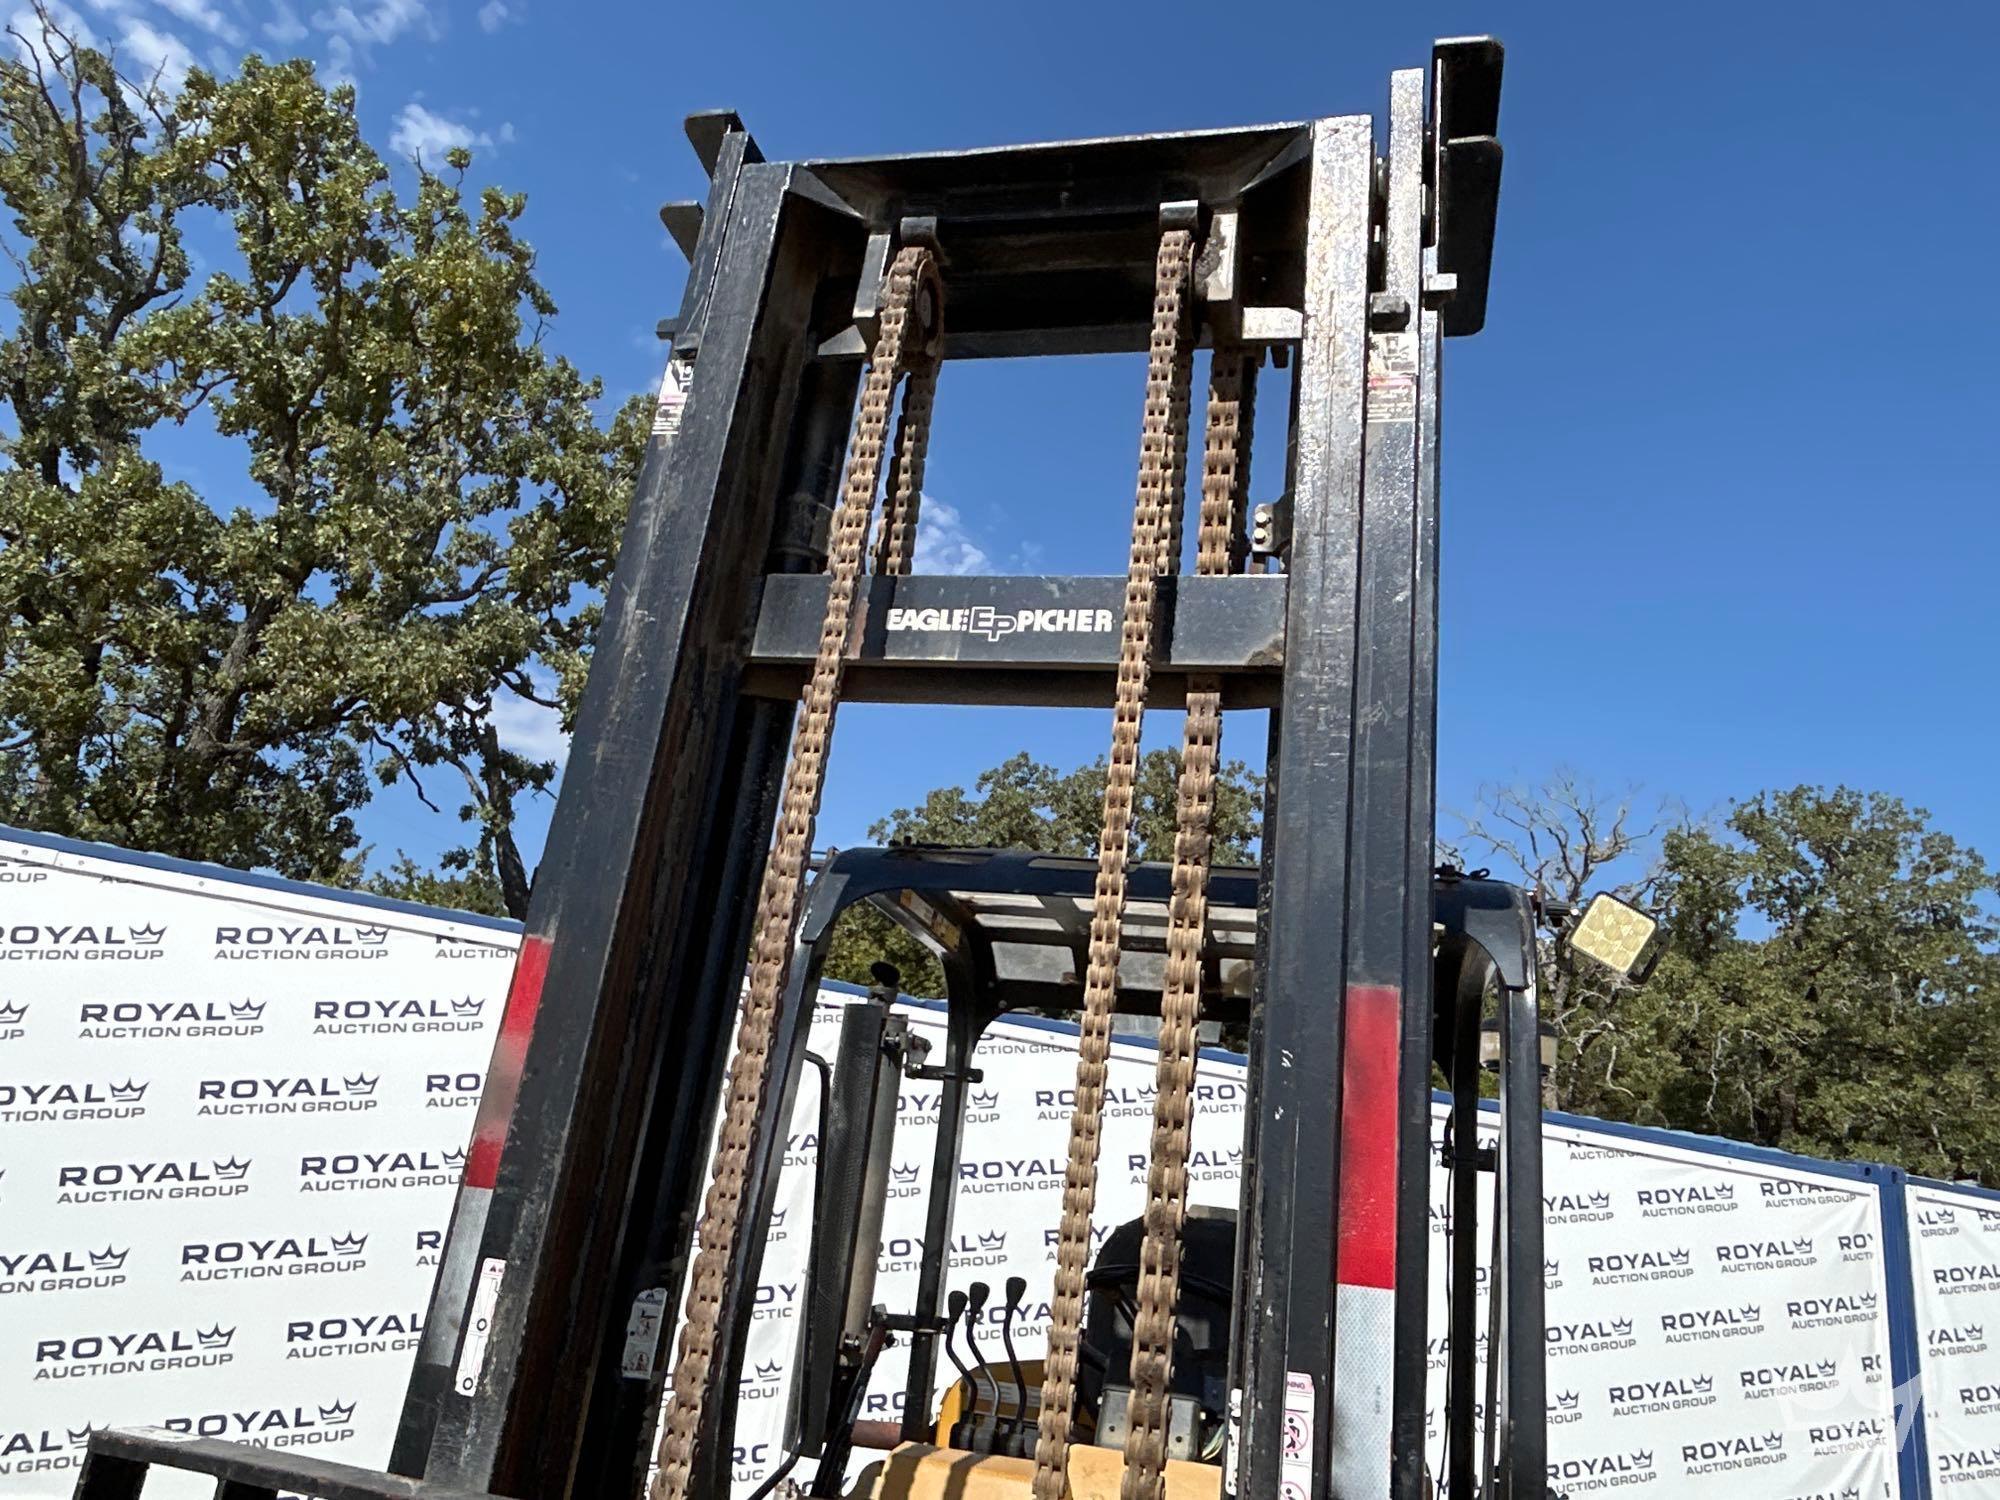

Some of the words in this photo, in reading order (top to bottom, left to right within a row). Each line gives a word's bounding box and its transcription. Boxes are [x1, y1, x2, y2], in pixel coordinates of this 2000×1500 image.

[886, 608, 969, 632] EAGLE
[1016, 608, 1114, 633] PICHER
[0, 872, 47, 884] OUP
[0, 926, 126, 945] OYAL
[215, 926, 352, 945] ROYAL
[0, 949, 79, 961] CTION
[84, 949, 165, 961] GROUP
[214, 949, 311, 960] AUCTION
[315, 949, 389, 960] GROUP
[80, 1002, 226, 1023] ROYAL
[313, 999, 448, 1020] ROYAL
[78, 1026, 181, 1039] AUCTION
[186, 1024, 264, 1037] GROUP
[312, 1022, 408, 1035] AUCTION
[412, 1020, 484, 1033] GROUP
[0, 1083, 105, 1106] OYAL
[198, 1077, 340, 1100] ROYAL
[197, 1102, 297, 1116] AUCTION
[301, 1099, 378, 1113] GROUP
[425, 1096, 481, 1108] AUCT
[1111, 1106, 1155, 1118] GROU
[1, 1109, 57, 1123] TION
[63, 1106, 146, 1120] GROUP
[58, 1161, 210, 1187] ROYAL
[300, 1152, 440, 1177] ROYAL
[960, 1159, 1068, 1179] ROYAL
[299, 1177, 397, 1192] AUCTION
[401, 1174, 462, 1188] GROU
[960, 1180, 1035, 1194] AUCTION
[56, 1187, 163, 1204] AUCTION
[168, 1183, 250, 1199] GROUP
[1637, 1185, 1716, 1206] ROYAL
[1765, 1197, 1815, 1209] AUCTION
[1569, 1211, 1614, 1224] GROUP
[1642, 1205, 1695, 1218] AUCTION
[1698, 1202, 1738, 1213] GROUP
[181, 1237, 328, 1265] ROYAL
[1588, 1249, 1671, 1273] ROYAL
[1716, 1241, 1794, 1262] ROYAL
[0, 1251, 86, 1276] YAL
[180, 1264, 284, 1282] AUCTION
[288, 1259, 367, 1276] GROUP
[1721, 1261, 1774, 1274] AUCTION
[1776, 1256, 1817, 1269] GROUP
[40, 1274, 127, 1291] GROUP
[1592, 1273, 1648, 1286] AUCTION
[1650, 1268, 1694, 1281] GROUP
[1938, 1282, 1987, 1296] AUCTION
[1787, 1296, 1861, 1317] ROYAL
[1661, 1308, 1741, 1331] ROYAL
[1791, 1315, 1842, 1330] AUCTION
[1545, 1321, 1612, 1343] OYAL
[1665, 1330, 1720, 1344] AUCTION
[1722, 1324, 1765, 1338] GROUP
[35, 1330, 194, 1363] ROYAL
[285, 1341, 387, 1360] AUCTION
[1546, 1343, 1589, 1357] CTION
[1591, 1338, 1637, 1352] GROUP
[1948, 1344, 1988, 1357] GROUP
[32, 1359, 145, 1381] AUCTION
[150, 1352, 234, 1371] GROUP
[1740, 1363, 1819, 1387] ROYAL
[1609, 1379, 1693, 1404] ROYAL
[1744, 1384, 1797, 1400] AUCTION
[1799, 1379, 1840, 1393] GROUP
[1612, 1401, 1670, 1417] AUCTION
[1672, 1395, 1717, 1411] GROUP
[274, 1429, 354, 1448] GROUP
[1809, 1418, 1884, 1444] ROYAL
[1682, 1436, 1763, 1462] ROYAL
[1686, 1459, 1742, 1476] AUCTION
[1744, 1452, 1787, 1467] GROUP
[1556, 1478, 1608, 1494] UCTION
[1610, 1471, 1657, 1488] GROUP
[1940, 1473, 1976, 1484] CTION
